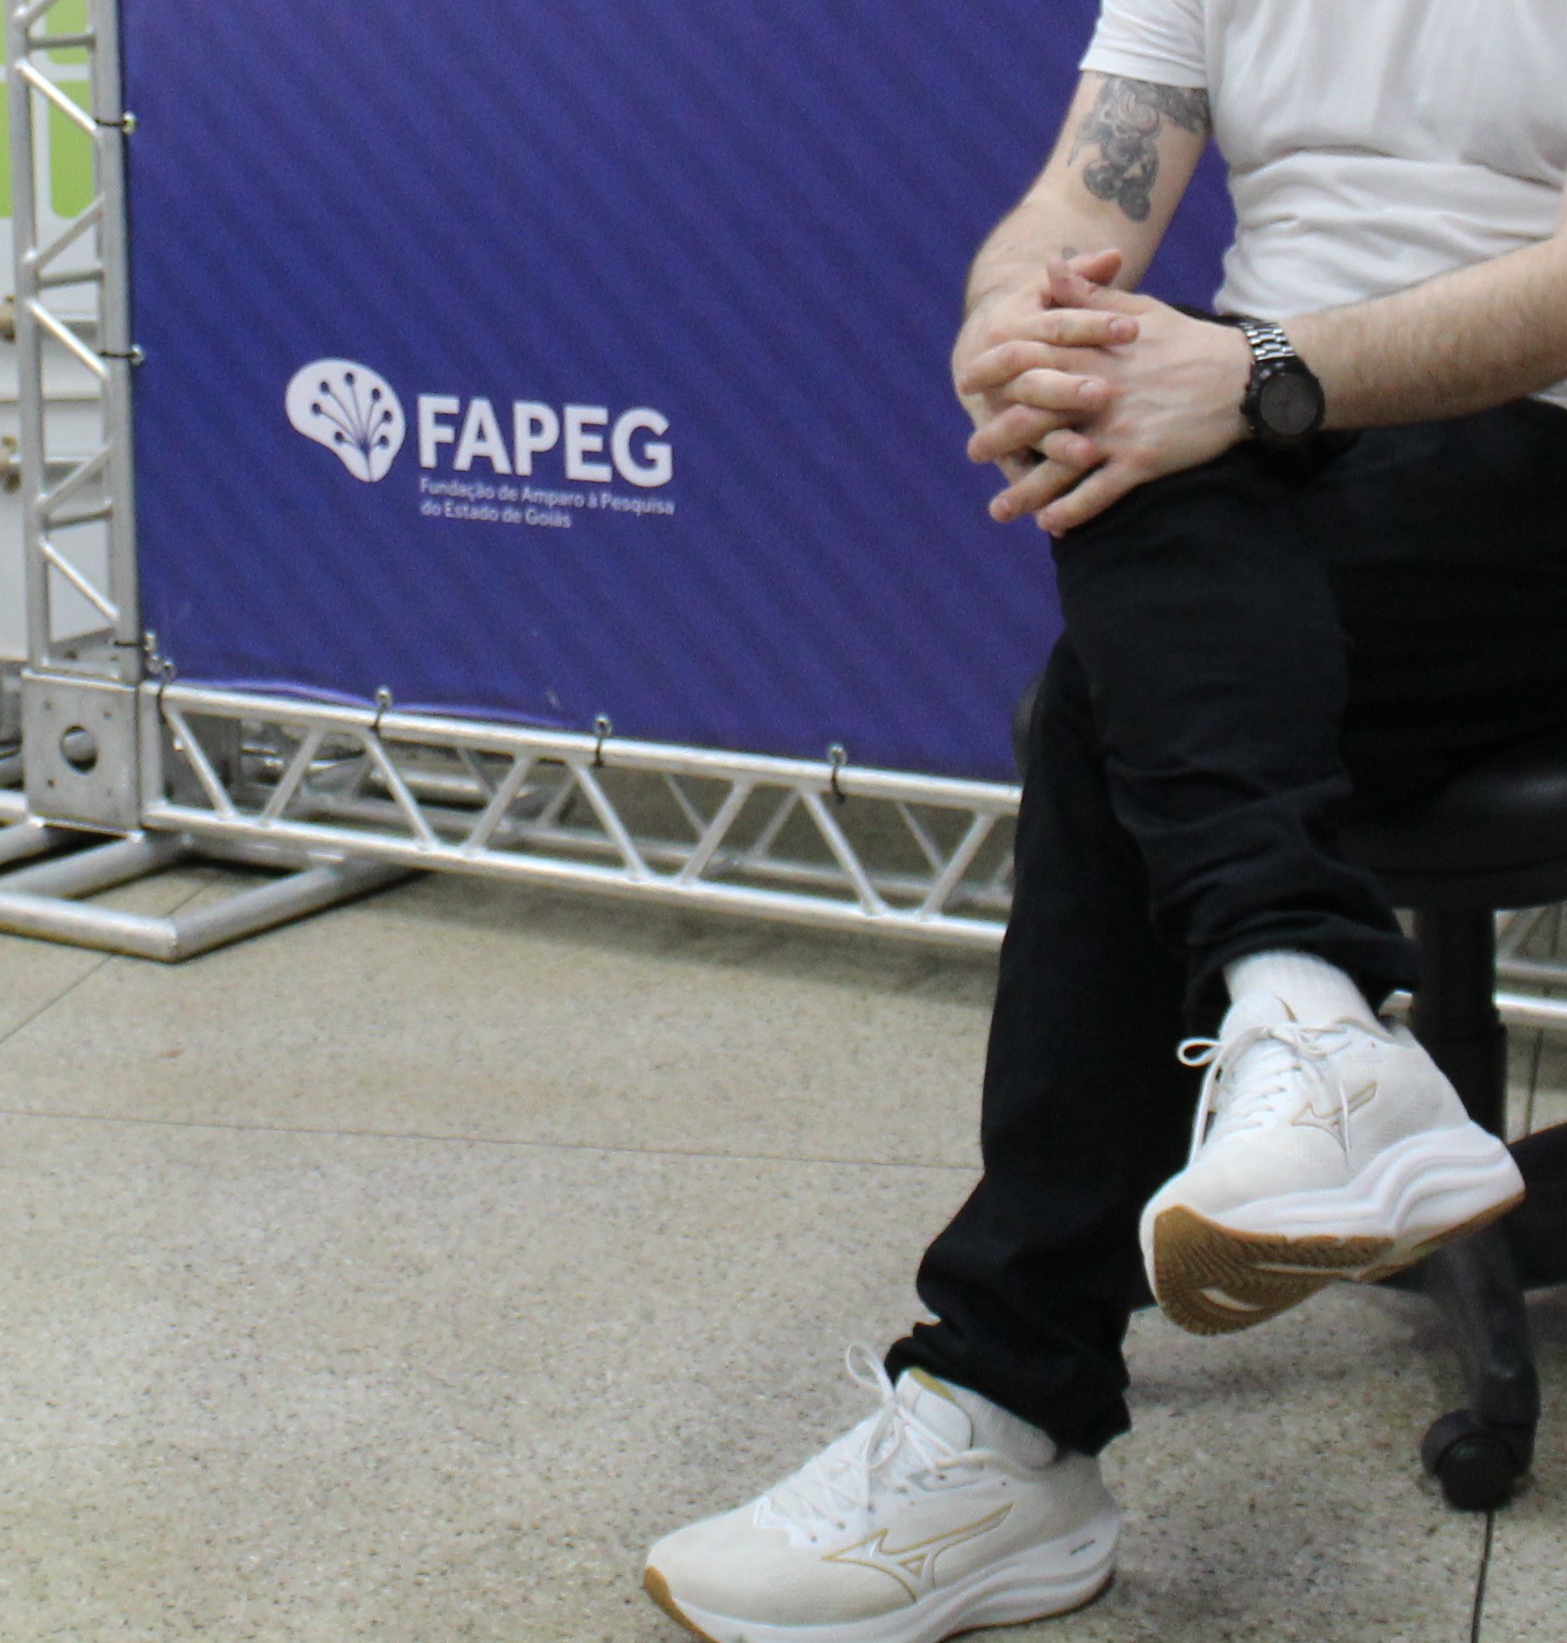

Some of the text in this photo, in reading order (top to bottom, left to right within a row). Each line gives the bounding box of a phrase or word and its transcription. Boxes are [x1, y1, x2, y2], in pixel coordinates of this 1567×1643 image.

[417, 393, 673, 487] FAPEG
[419, 476, 494, 502] Fundação
[498, 485, 518, 502] de
[521, 485, 585, 509] Amparo
[600, 492, 674, 517] Pesquisa
[420, 500, 571, 528] do Estado de Goiás
